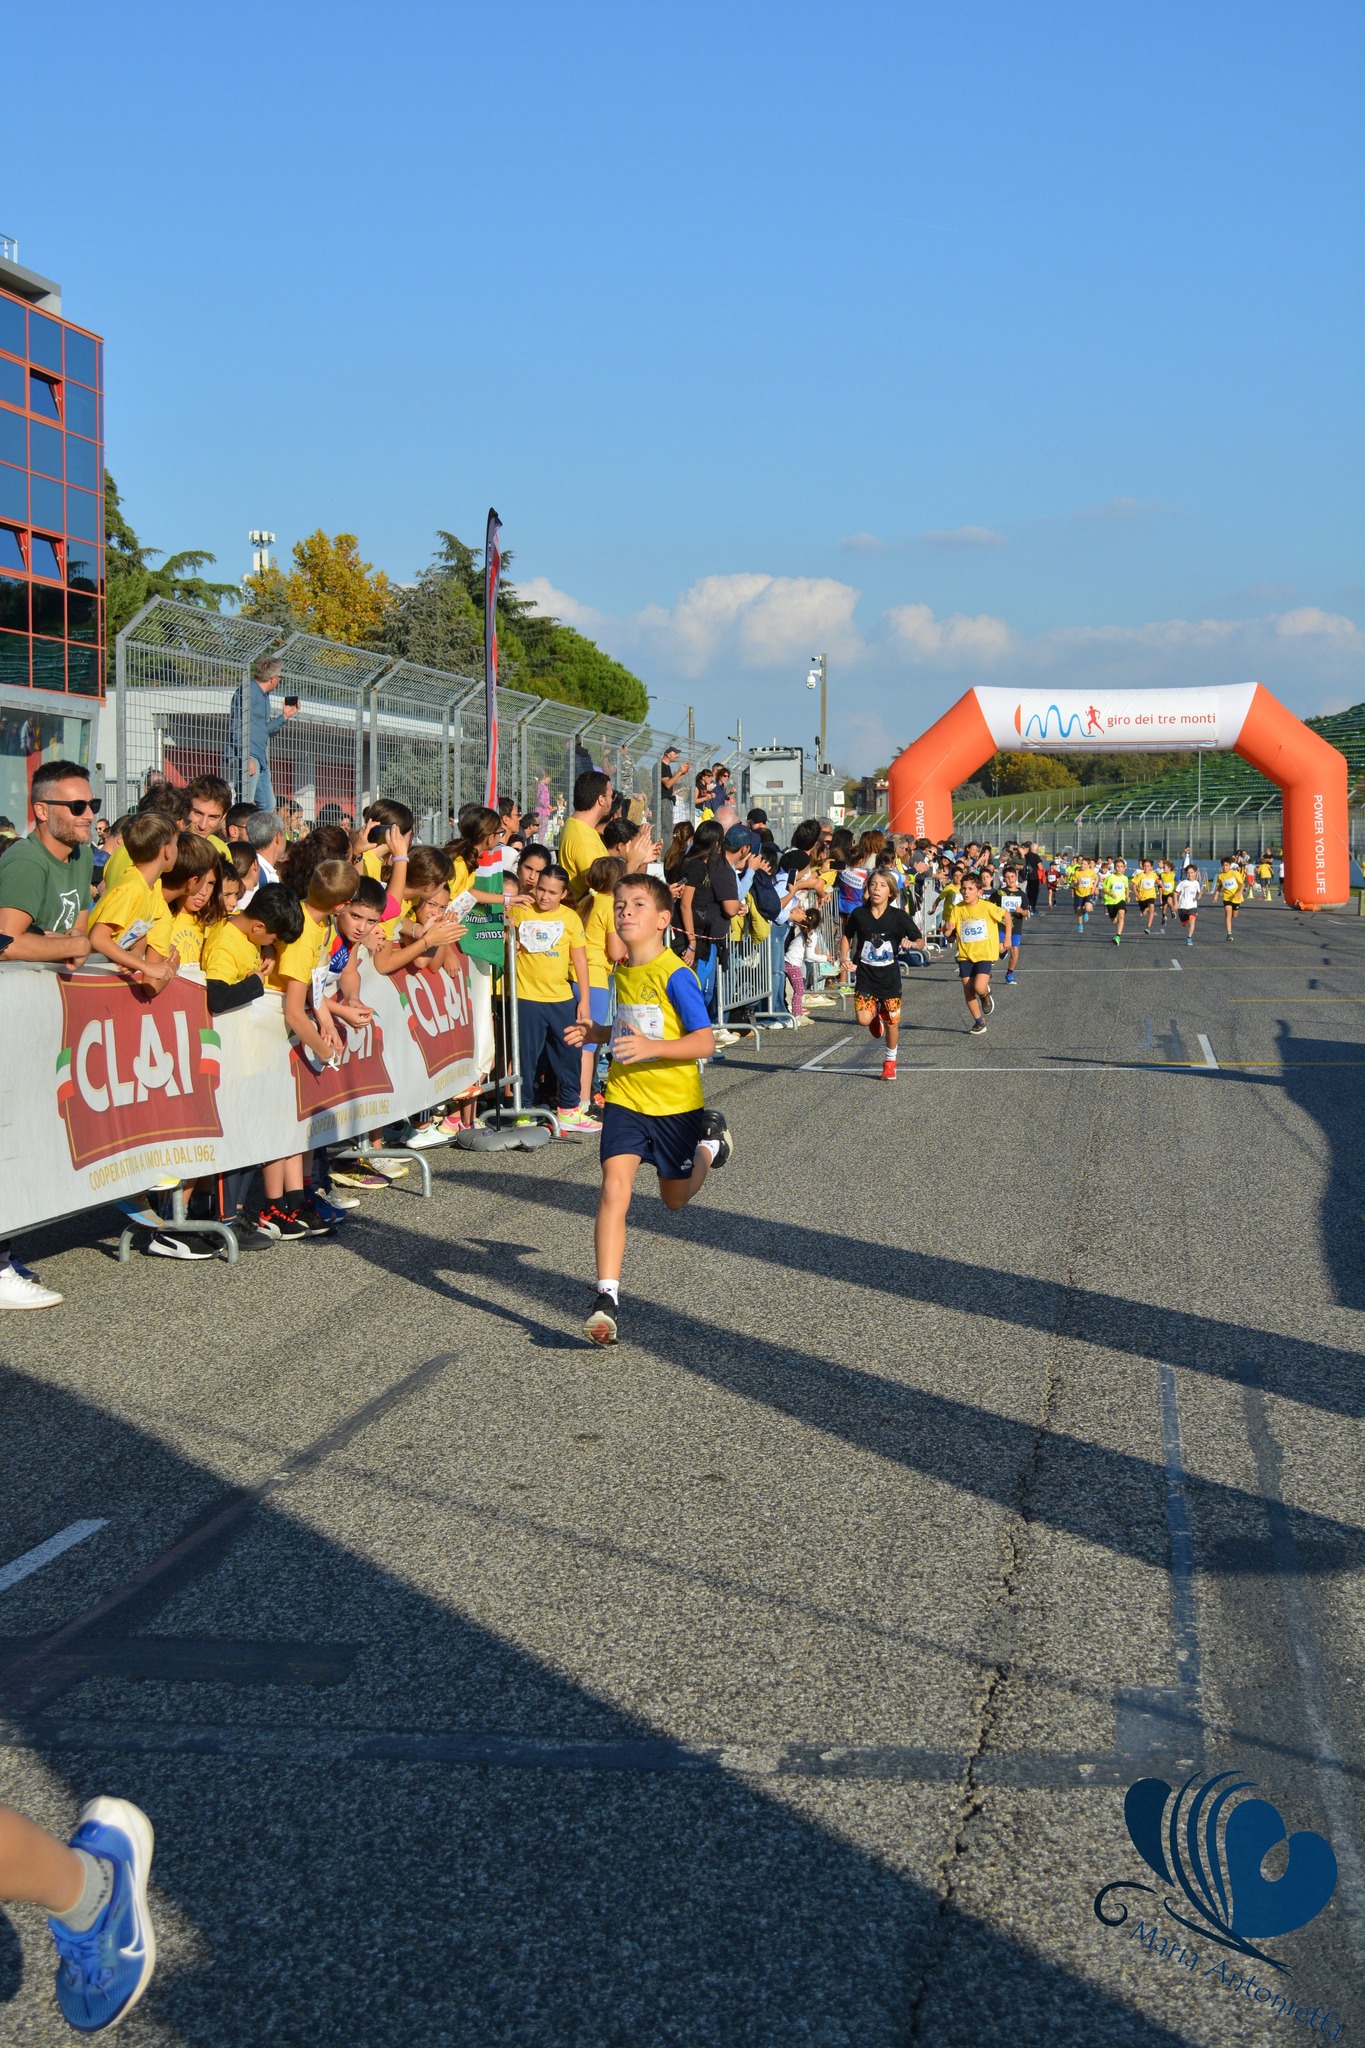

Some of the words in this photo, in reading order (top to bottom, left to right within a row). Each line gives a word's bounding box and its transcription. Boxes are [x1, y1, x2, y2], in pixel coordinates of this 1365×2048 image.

[1107, 714, 1131, 727] giro
[1134, 713, 1154, 725] dei
[1158, 714, 1176, 725] tre
[1180, 712, 1216, 724] monti
[914, 800, 925, 839] POWER
[1313, 794, 1324, 834] POWER
[1315, 838, 1325, 869] YOUR
[1315, 872, 1326, 894] LIFE
[964, 926, 983, 936] 652
[405, 966, 469, 1037] CLAI
[76, 1010, 194, 1113] CLAI
[89, 1156, 139, 1191] COOPERATIVA
[145, 1148, 173, 1169] IMOLA
[173, 1146, 193, 1164] DAL
[193, 1145, 216, 1163] 1962
